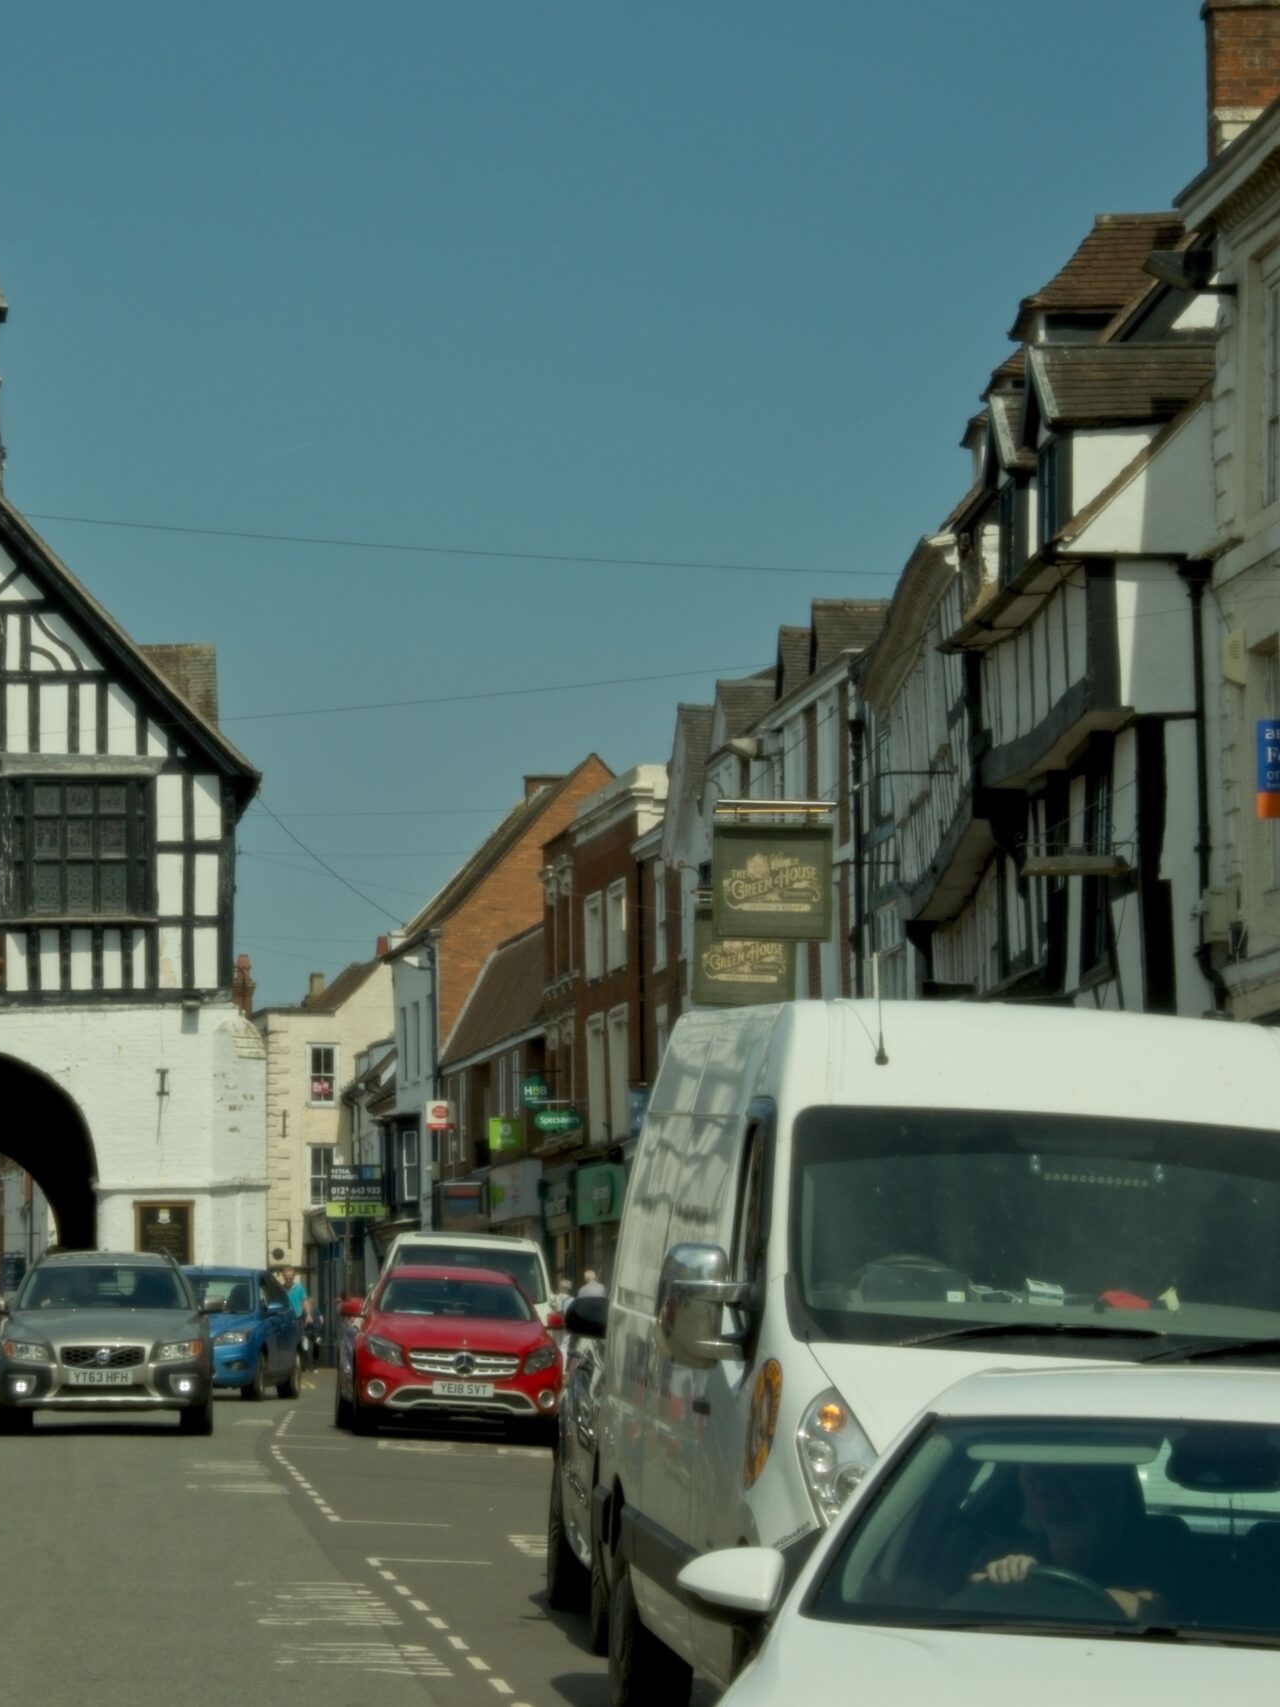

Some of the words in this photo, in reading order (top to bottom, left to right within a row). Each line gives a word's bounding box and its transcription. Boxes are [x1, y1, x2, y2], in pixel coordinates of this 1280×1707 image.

[731, 869, 746, 879] THE
[731, 878, 772, 900] GREEN
[774, 866, 817, 888] HOUSE
[709, 951, 745, 971] GREEN
[746, 943, 784, 962] HOUSE
[540, 1116, 580, 1125] Specsavers
[337, 1204, 355, 1214] TO
[359, 1204, 377, 1214] LET
[73, 1371, 103, 1383] YT63
[106, 1371, 128, 1383] HFH
[440, 1383, 464, 1394] YE18
[467, 1384, 488, 1395] SVT
